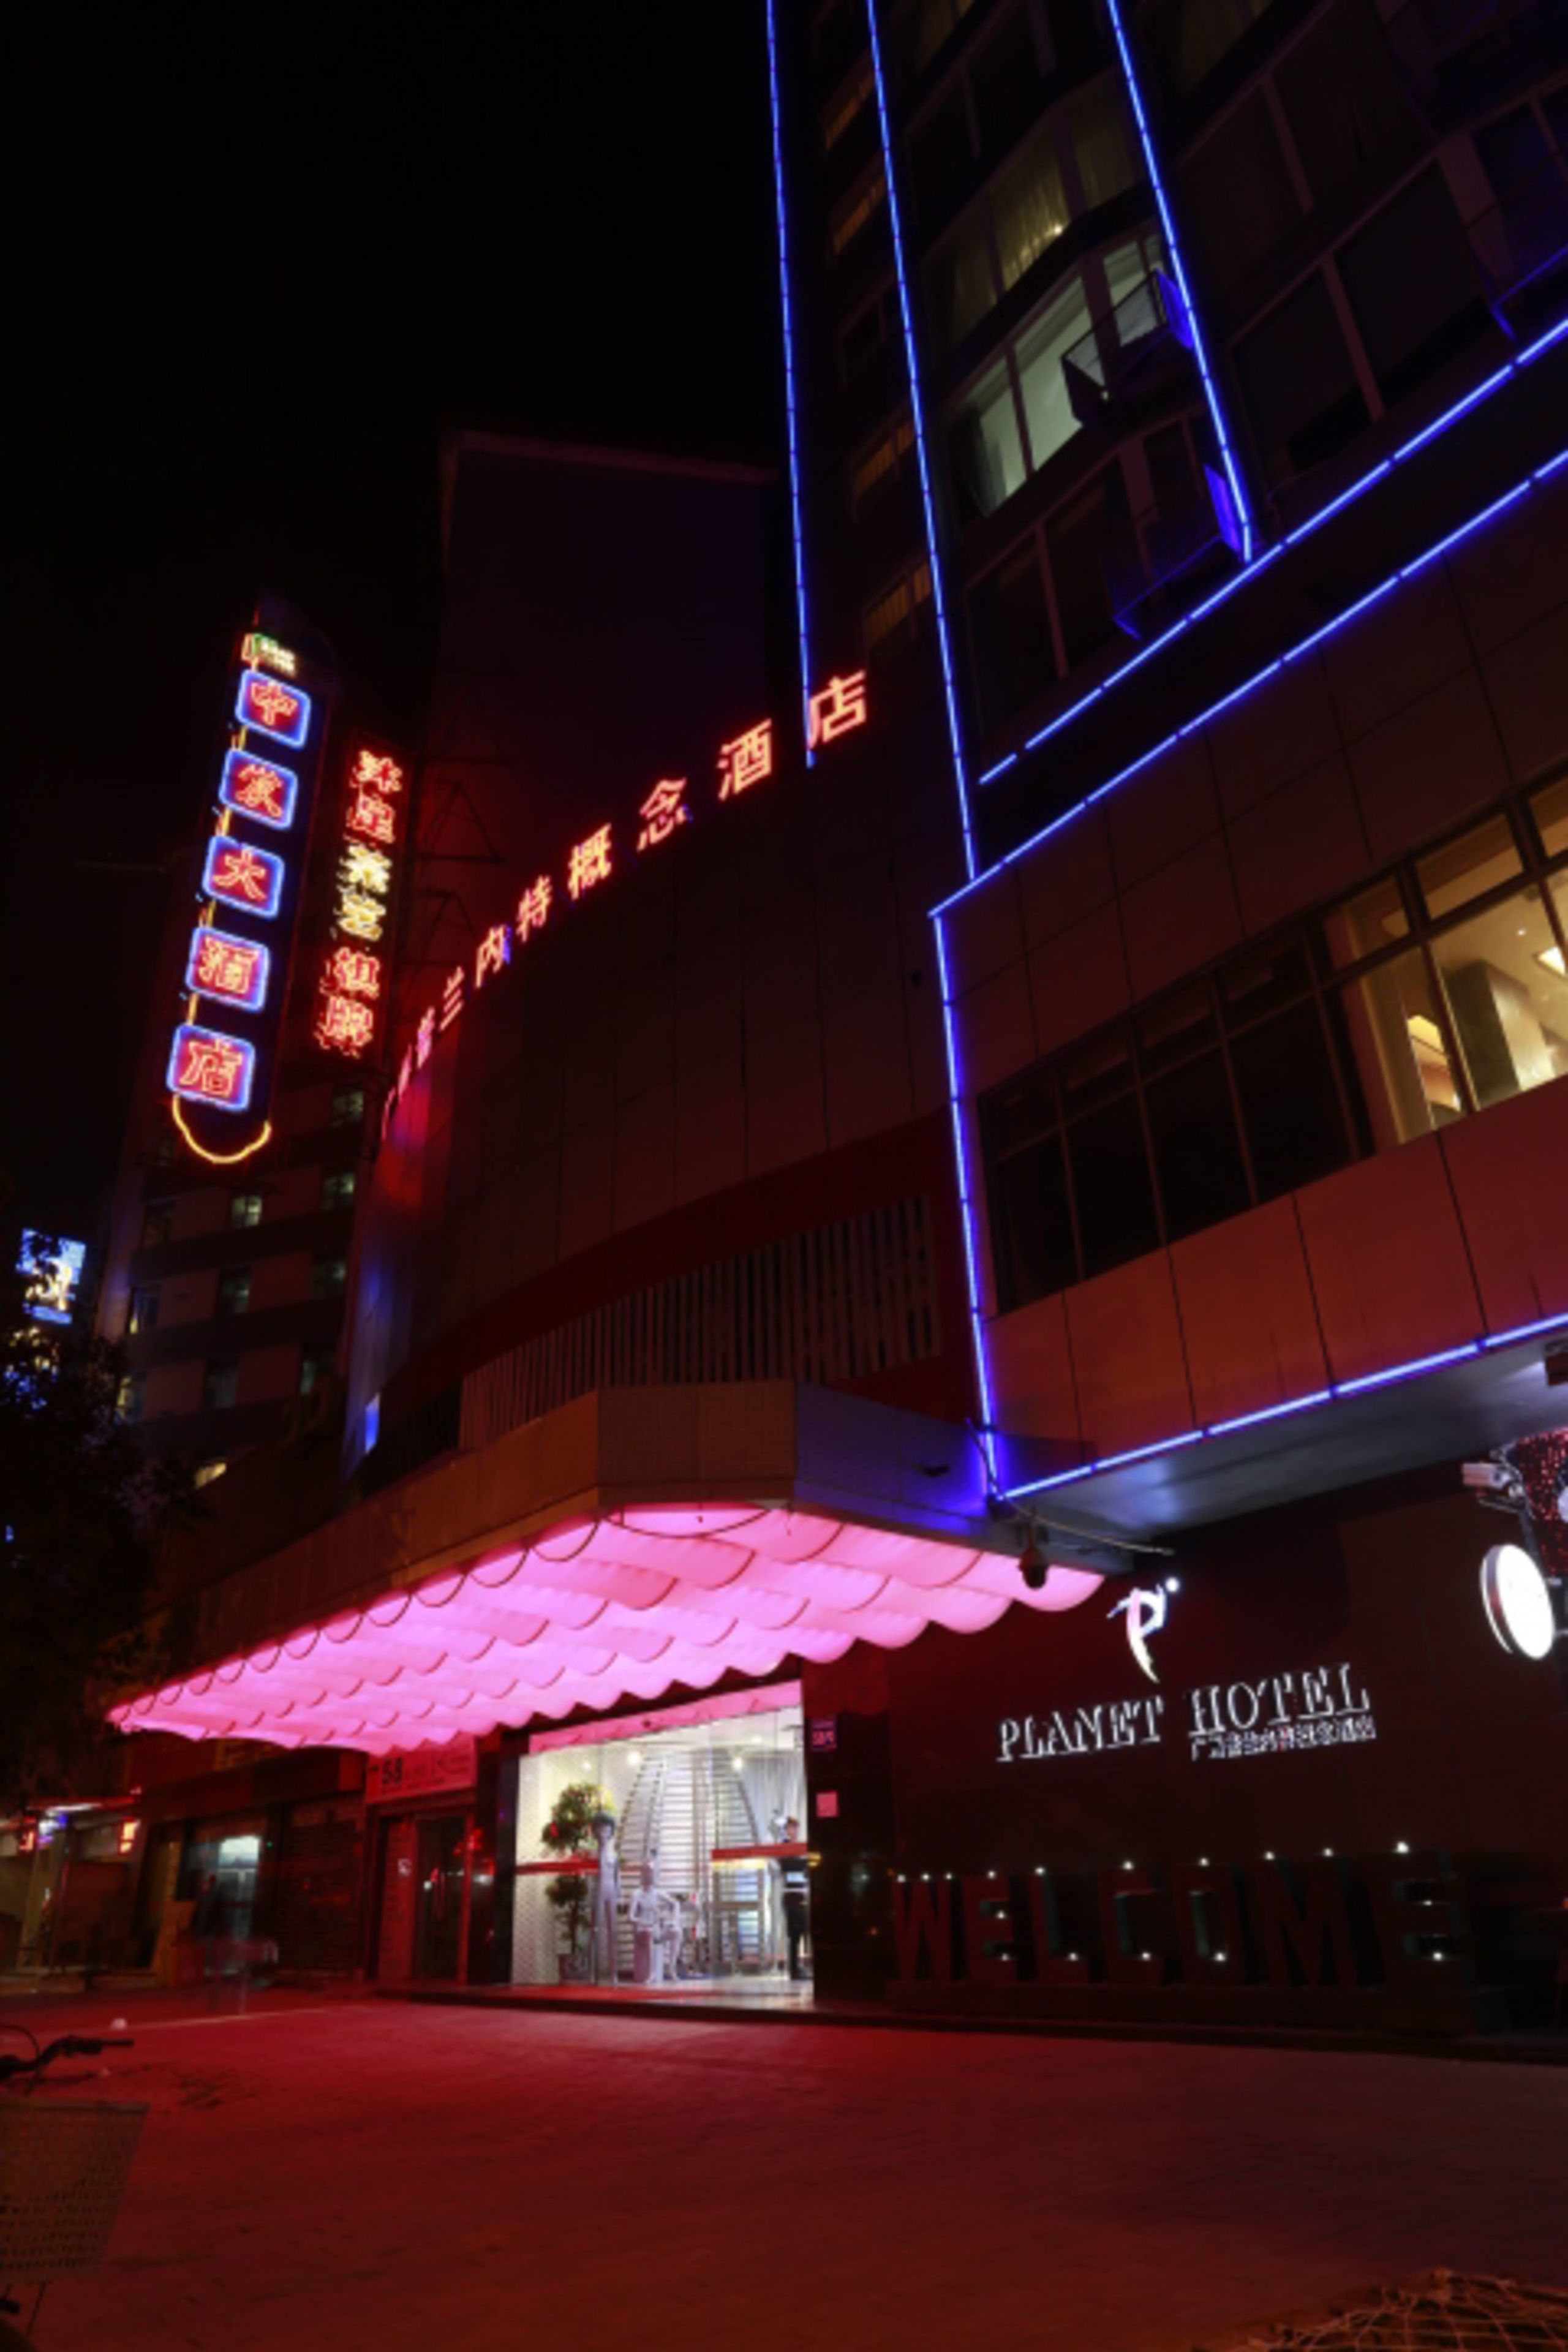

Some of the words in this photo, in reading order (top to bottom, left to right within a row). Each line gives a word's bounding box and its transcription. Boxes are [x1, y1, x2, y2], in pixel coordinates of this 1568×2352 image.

[997, 1695, 1164, 1762] PLANET
[1187, 1662, 1373, 1737] HOTEL
[892, 1845, 1466, 1987] WELCOME
